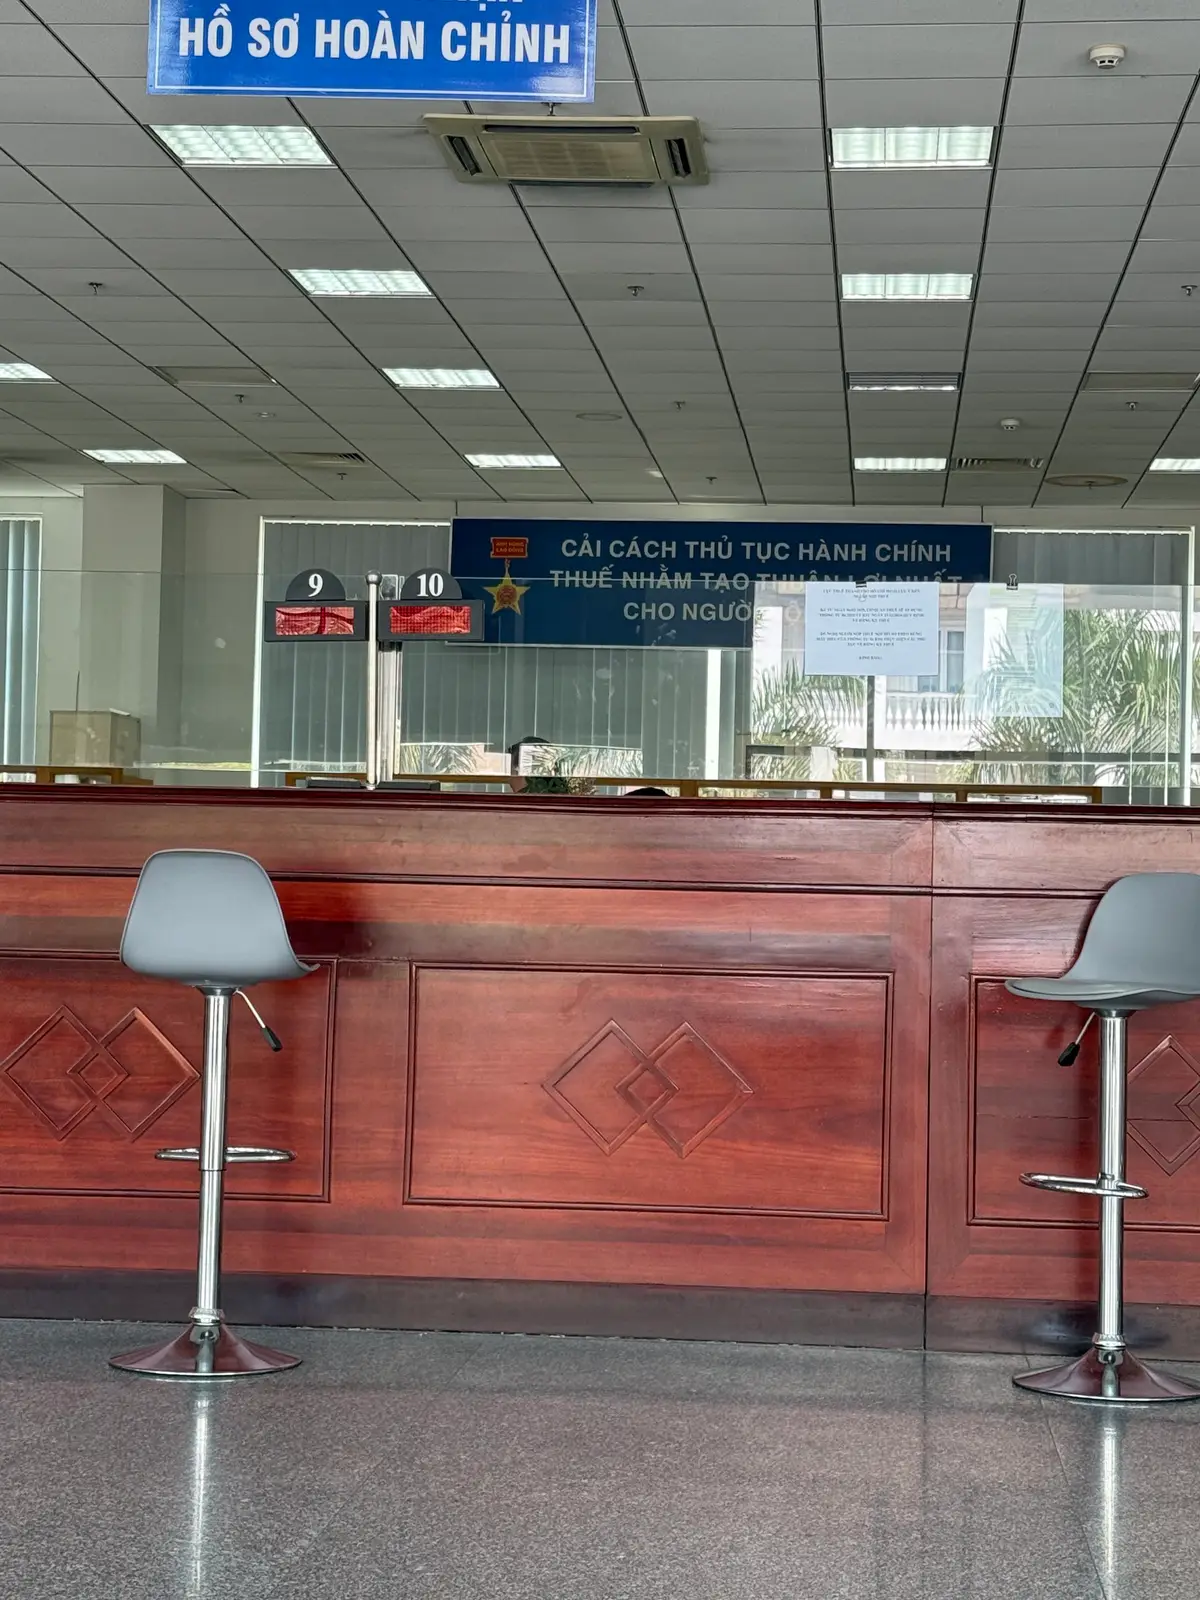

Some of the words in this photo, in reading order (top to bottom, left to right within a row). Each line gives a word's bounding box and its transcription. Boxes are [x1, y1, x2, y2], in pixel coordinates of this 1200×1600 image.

[179, 3, 233, 58] HỒ
[247, 12, 300, 59] SƠ
[314, 10, 424, 60] HOÀN
[441, 10, 570, 63] CHỈNH
[561, 533, 601, 557] CẢI
[609, 536, 676, 558] CÁCH
[684, 535, 732, 559] THỦ
[741, 542, 790, 563] TỤC
[798, 538, 866, 561] HÀNH
[875, 540, 951, 562] CHÍNH
[308, 573, 323, 597] 9
[417, 573, 444, 597] 10
[550, 564, 614, 588] THUẾ
[622, 564, 691, 589] NHẰM
[700, 572, 750, 593] TẠO
[623, 602, 675, 620] CHO
[682, 599, 753, 622] NGƯỜ
